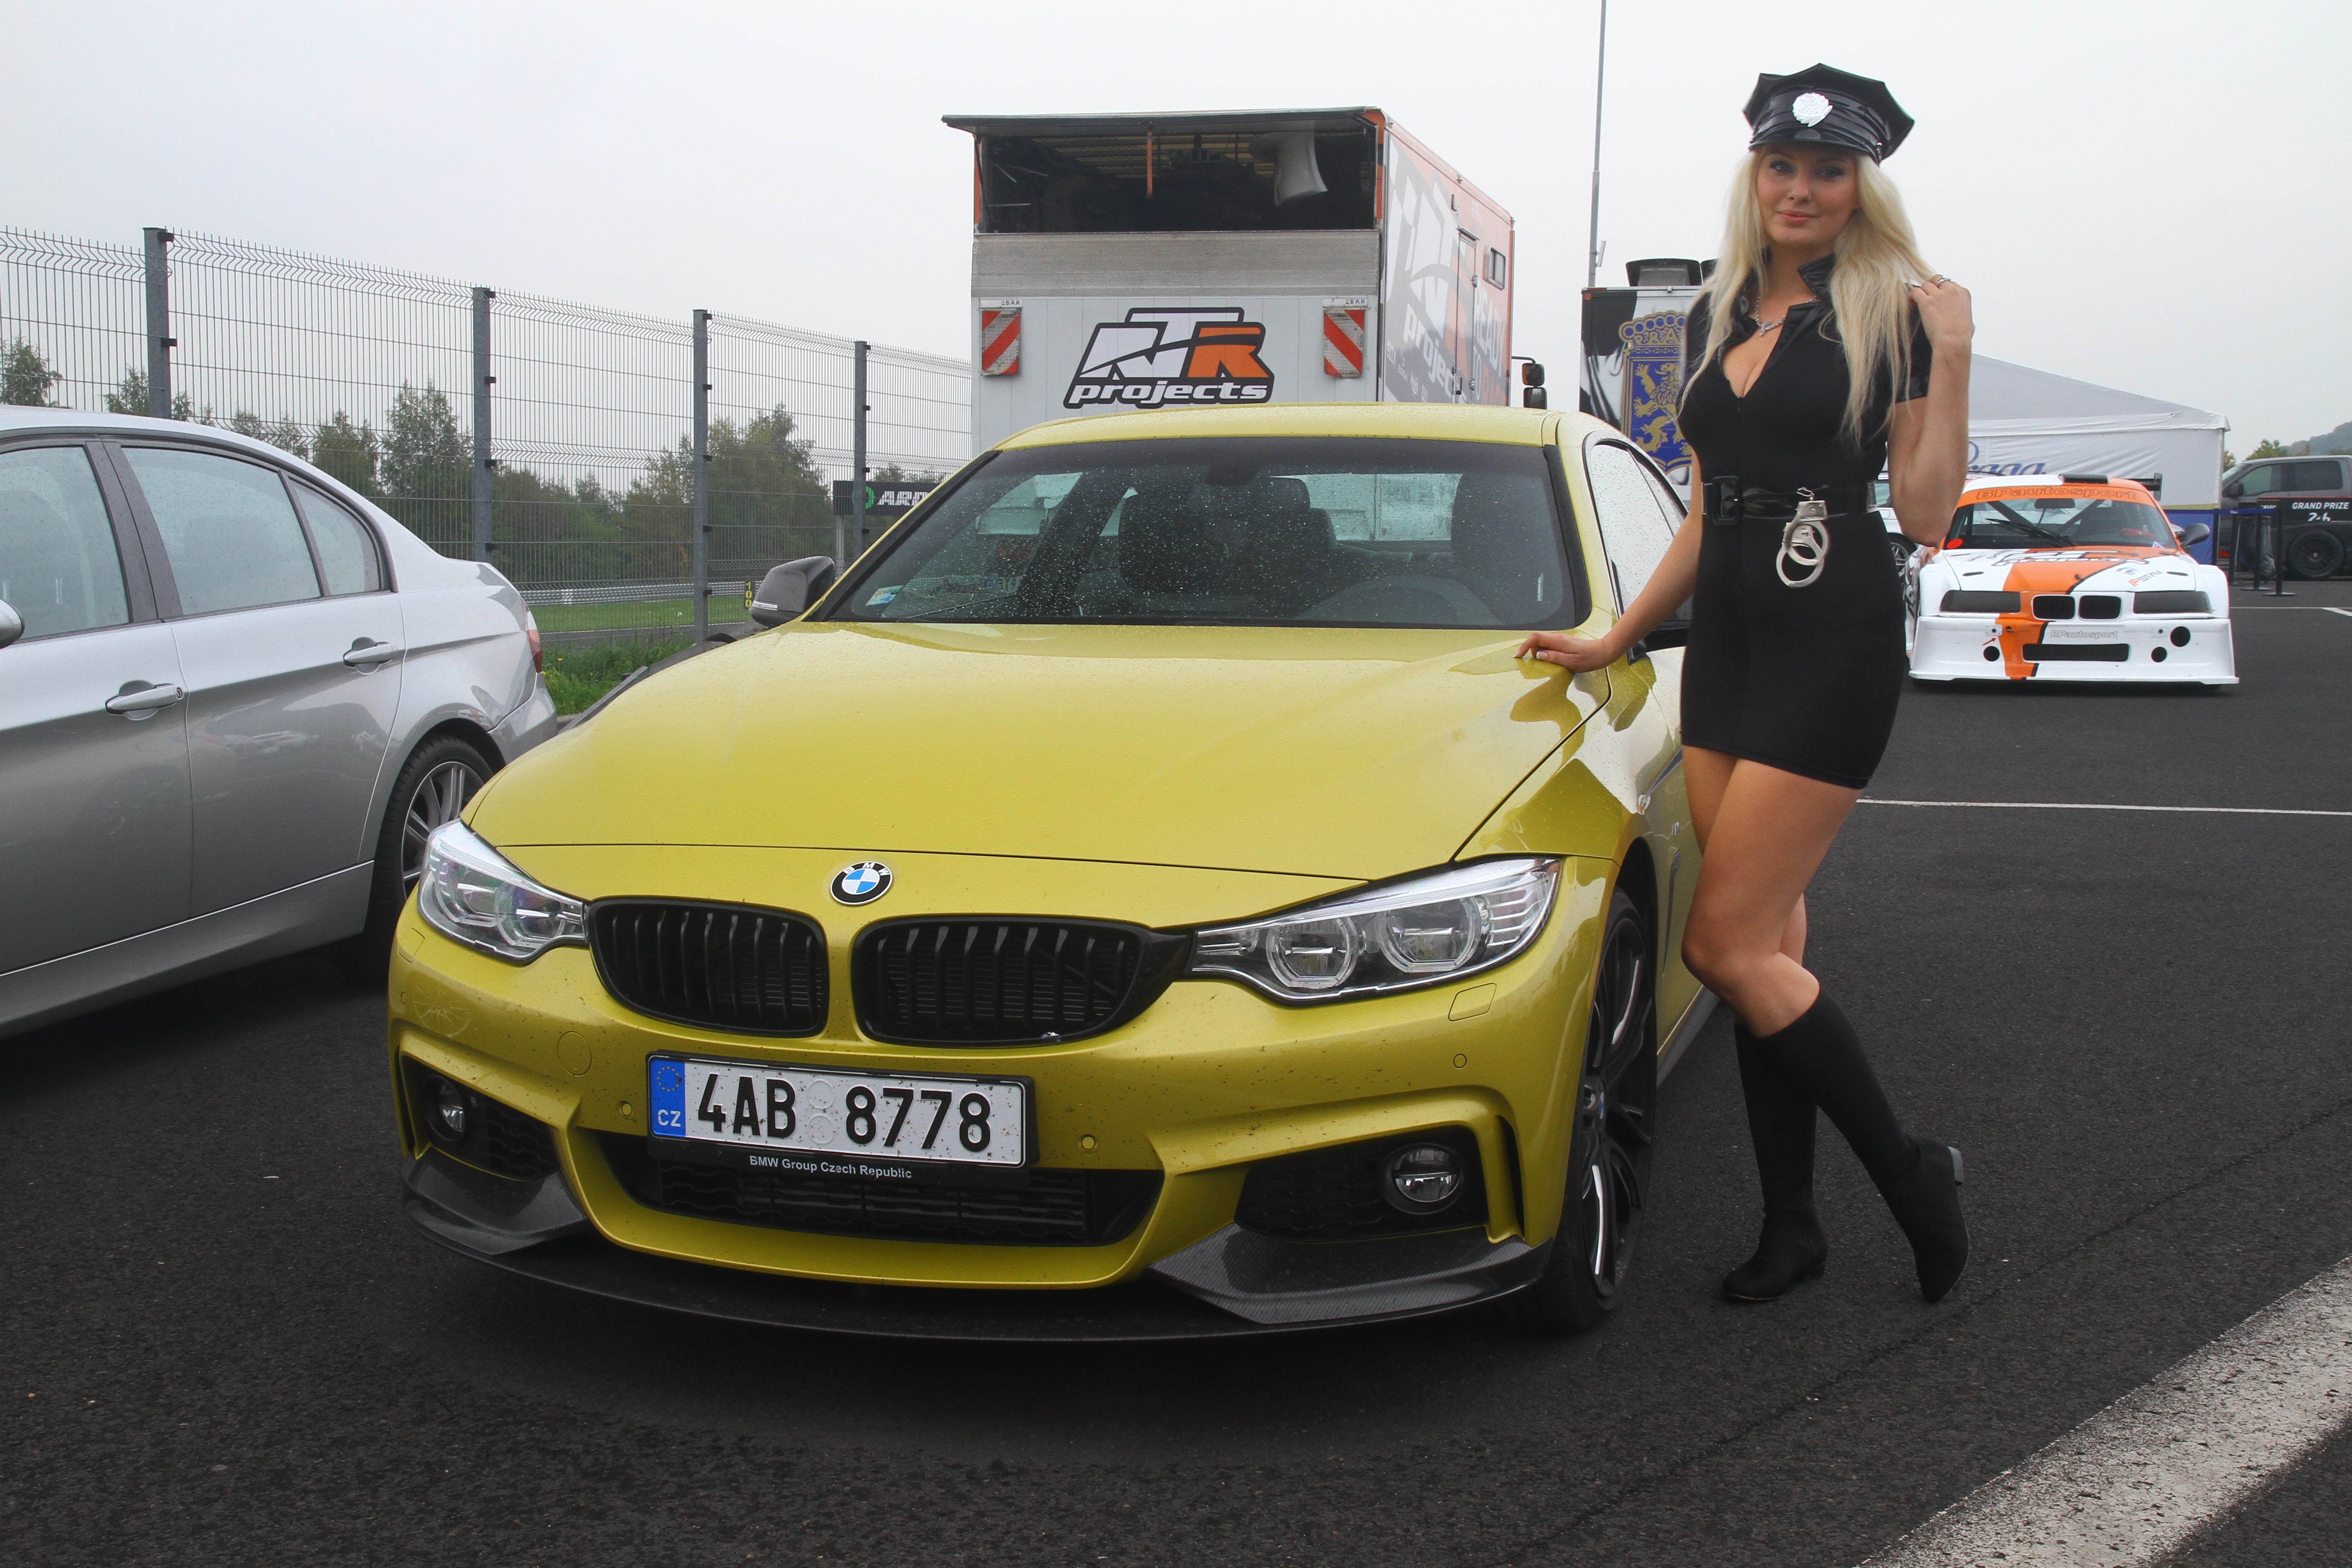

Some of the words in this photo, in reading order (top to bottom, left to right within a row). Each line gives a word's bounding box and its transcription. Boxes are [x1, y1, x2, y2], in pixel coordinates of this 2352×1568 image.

[1068, 380, 1267, 403] projects
[1976, 487, 2138, 500] BPautosport
[2050, 630, 2118, 639] BPautosport
[843, 862, 890, 876] BMW
[658, 1109, 681, 1127] CZ
[698, 1073, 796, 1137] 4AB
[846, 1086, 990, 1152] 8778
[750, 1156, 778, 1167] BMW
[782, 1158, 817, 1173] Group
[821, 1162, 856, 1174] Czech
[860, 1165, 912, 1178] Republic
